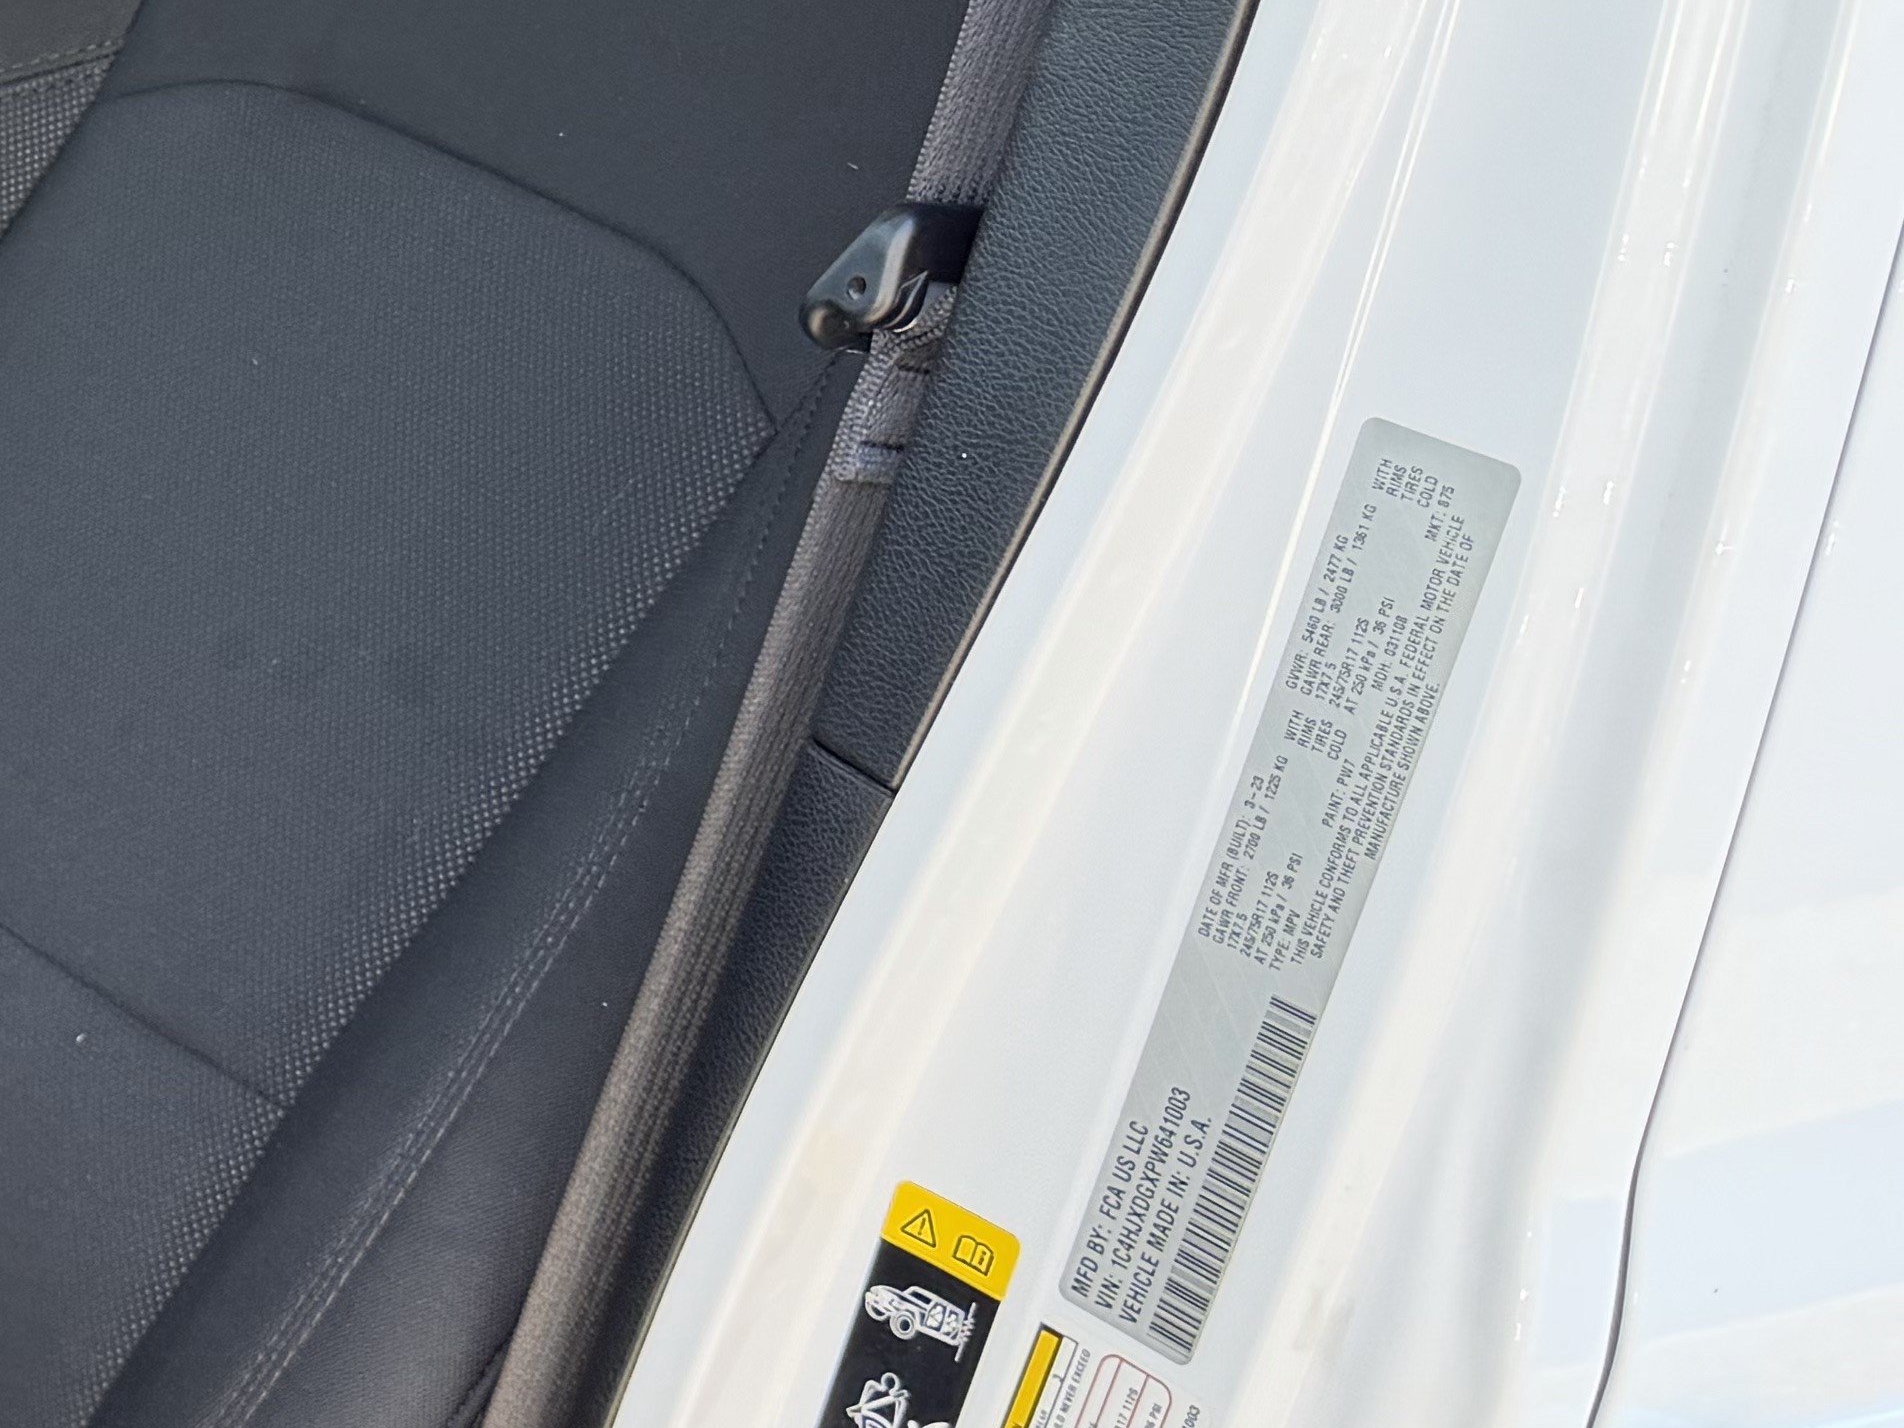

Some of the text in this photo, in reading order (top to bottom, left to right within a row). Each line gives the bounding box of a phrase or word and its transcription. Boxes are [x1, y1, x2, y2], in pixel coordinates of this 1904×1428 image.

[1385, 463, 1407, 497] RIMS
[1416, 474, 1439, 509] COLD
[1350, 616, 1369, 645] 112S
[1400, 465, 1424, 503] TIRES
[1435, 513, 1466, 565] VEHICLE
[1299, 657, 1323, 696] GAWR
[1313, 619, 1336, 657] REAR:
[1339, 566, 1355, 583] LB
[1351, 523, 1370, 550] 1361
[1361, 503, 1377, 521] KG
[1371, 457, 1393, 492] WITH
[1383, 614, 1408, 657] 031108
[1424, 509, 1446, 542] MKT:
[1436, 484, 1455, 508] 875
[1419, 567, 1446, 611] MOTOR
[1284, 648, 1309, 690] GVWR:
[1301, 614, 1321, 643] 5460
[1311, 596, 1327, 613] LB
[1322, 553, 1342, 582] 2477
[1333, 533, 1349, 552] KG
[1377, 596, 1395, 618] PSI
[1371, 619, 1387, 635] 36
[1399, 612, 1430, 668] FEDERAL
[1358, 649, 1376, 672] kPa
[1350, 673, 1367, 695] 250
[1343, 697, 1359, 715] AT
[1283, 709, 1304, 742] WITH
[1296, 716, 1317, 748] RIMS
[1309, 533, 1476, 959] SAFETY AND THEFT PREVENTION STANDARDS IN EFFECT ON THE DATE OF
[1326, 728, 1347, 760] COLD
[1357, 709, 1394, 781] APPLICABLE
[1272, 754, 1288, 773] KG
[1363, 679, 1441, 860] MANUFACTURE SHOWN ABOVE.
[1263, 772, 1282, 801] 1225
[1349, 781, 1368, 805] ALL
[1252, 814, 1267, 831] LB
[1260, 870, 1279, 898] 112S
[1311, 718, 1333, 754] TIRES
[1342, 805, 1359, 823] TO
[1224, 813, 1253, 861] (BUILT):
[1269, 758, 1356, 972] TYPE: MPV PAINT: PW7
[1286, 851, 1303, 873] PSI
[1318, 824, 1352, 889] CONFORMS
[1214, 860, 1234, 888] MFR
[1225, 863, 1250, 908] FRONT:
[1280, 873, 1295, 890] 36
[1208, 888, 1224, 906] OF
[1268, 901, 1285, 924] kPa
[1300, 889, 1328, 937] VEHICLE
[1197, 905, 1218, 938] DATE
[1212, 908, 1234, 945] GAWR
[1260, 924, 1277, 947] 250
[1253, 946, 1268, 965] AT
[1290, 937, 1310, 966] THIS
[1070, 1119, 1149, 1298] MFD BY: FCA US LLC
[1094, 1084, 1191, 1312] VIN: 1C4HJXDGXPW641003
[1118, 1111, 1212, 1325] VEHICLE MADE IN: U.S.A.
